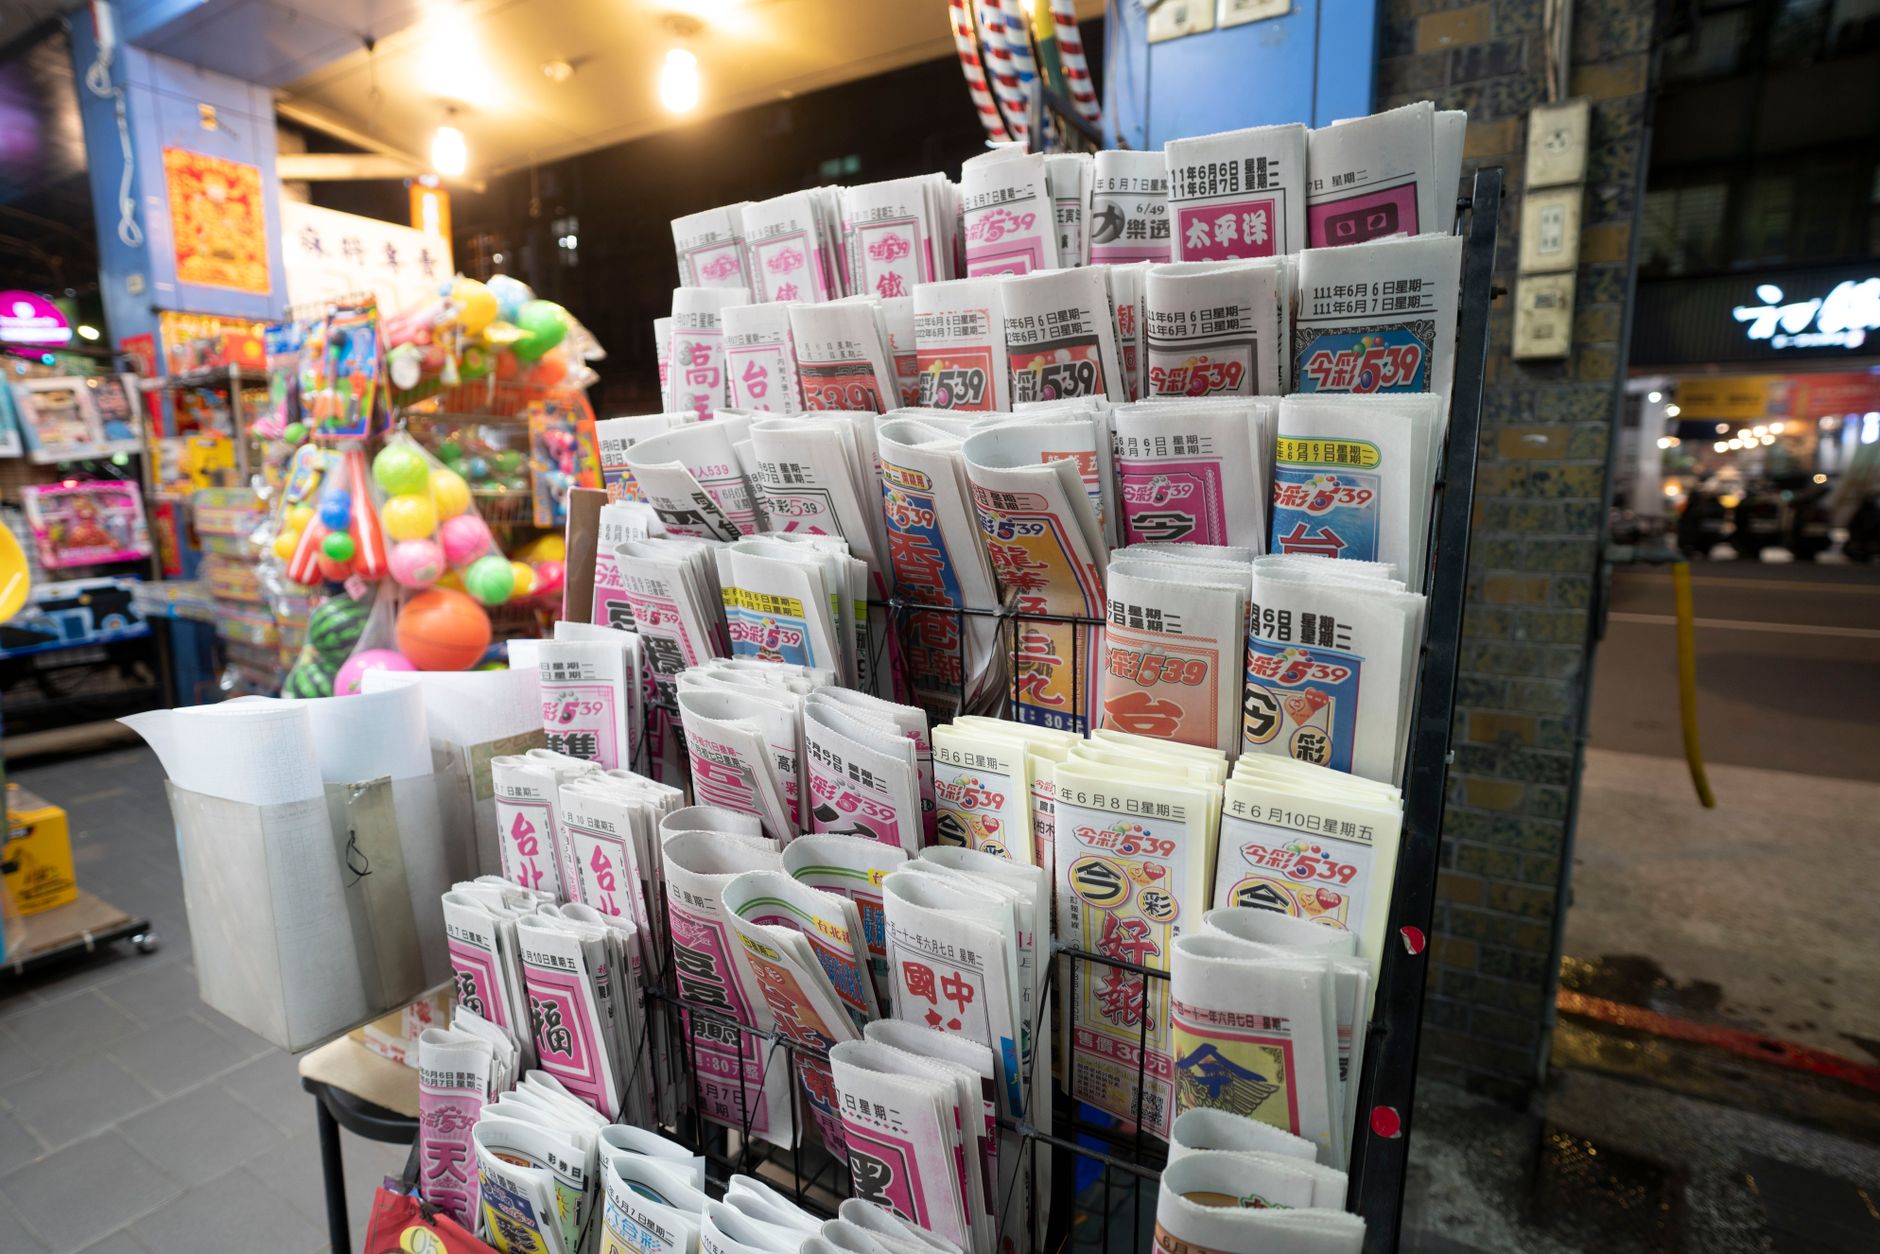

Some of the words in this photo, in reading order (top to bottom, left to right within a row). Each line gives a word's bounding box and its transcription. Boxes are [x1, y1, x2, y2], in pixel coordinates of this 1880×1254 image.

[1136, 203, 1165, 215] 6/49
[1186, 209, 1269, 249] 太平洋
[1313, 279, 1435, 299] 111年6月6日星期一
[1313, 294, 1433, 315] 111年6月7日星期二
[1306, 346, 1420, 394] 今彩539
[935, 778, 1005, 813] 今彩539
[1061, 786, 1187, 820] 年6月8日星期三
[1232, 799, 1374, 842] 年6月10日星期五
[1075, 824, 1177, 859] 今彩539
[1244, 842, 1359, 885] 今彩539
[1095, 911, 1161, 1031] 好報
